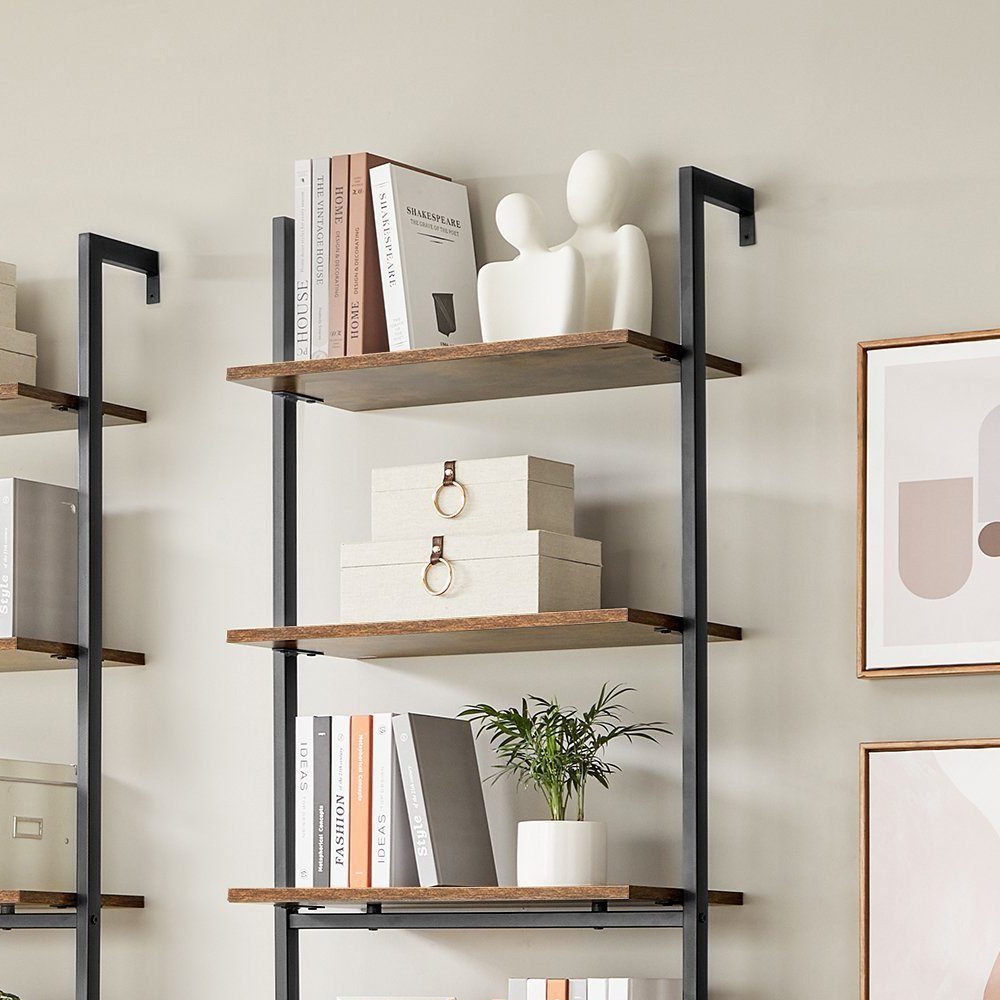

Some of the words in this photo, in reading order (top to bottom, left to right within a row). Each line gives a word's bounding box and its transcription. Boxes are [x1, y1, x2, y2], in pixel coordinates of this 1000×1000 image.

[316, 200, 324, 246] VINTAGE
[335, 186, 343, 225] HOME
[406, 206, 461, 228] SHAKESPEARE
[379, 192, 397, 288] SHAKESPEARE
[316, 249, 324, 286] HOUSE
[297, 280, 309, 343] HOUSE
[351, 301, 359, 339] HOME
[0, 575, 9, 615] Style
[300, 742, 308, 791] IDEAS
[336, 794, 344, 866] FASHION
[378, 814, 386, 863] IDEAS
[414, 816, 427, 857] Style
